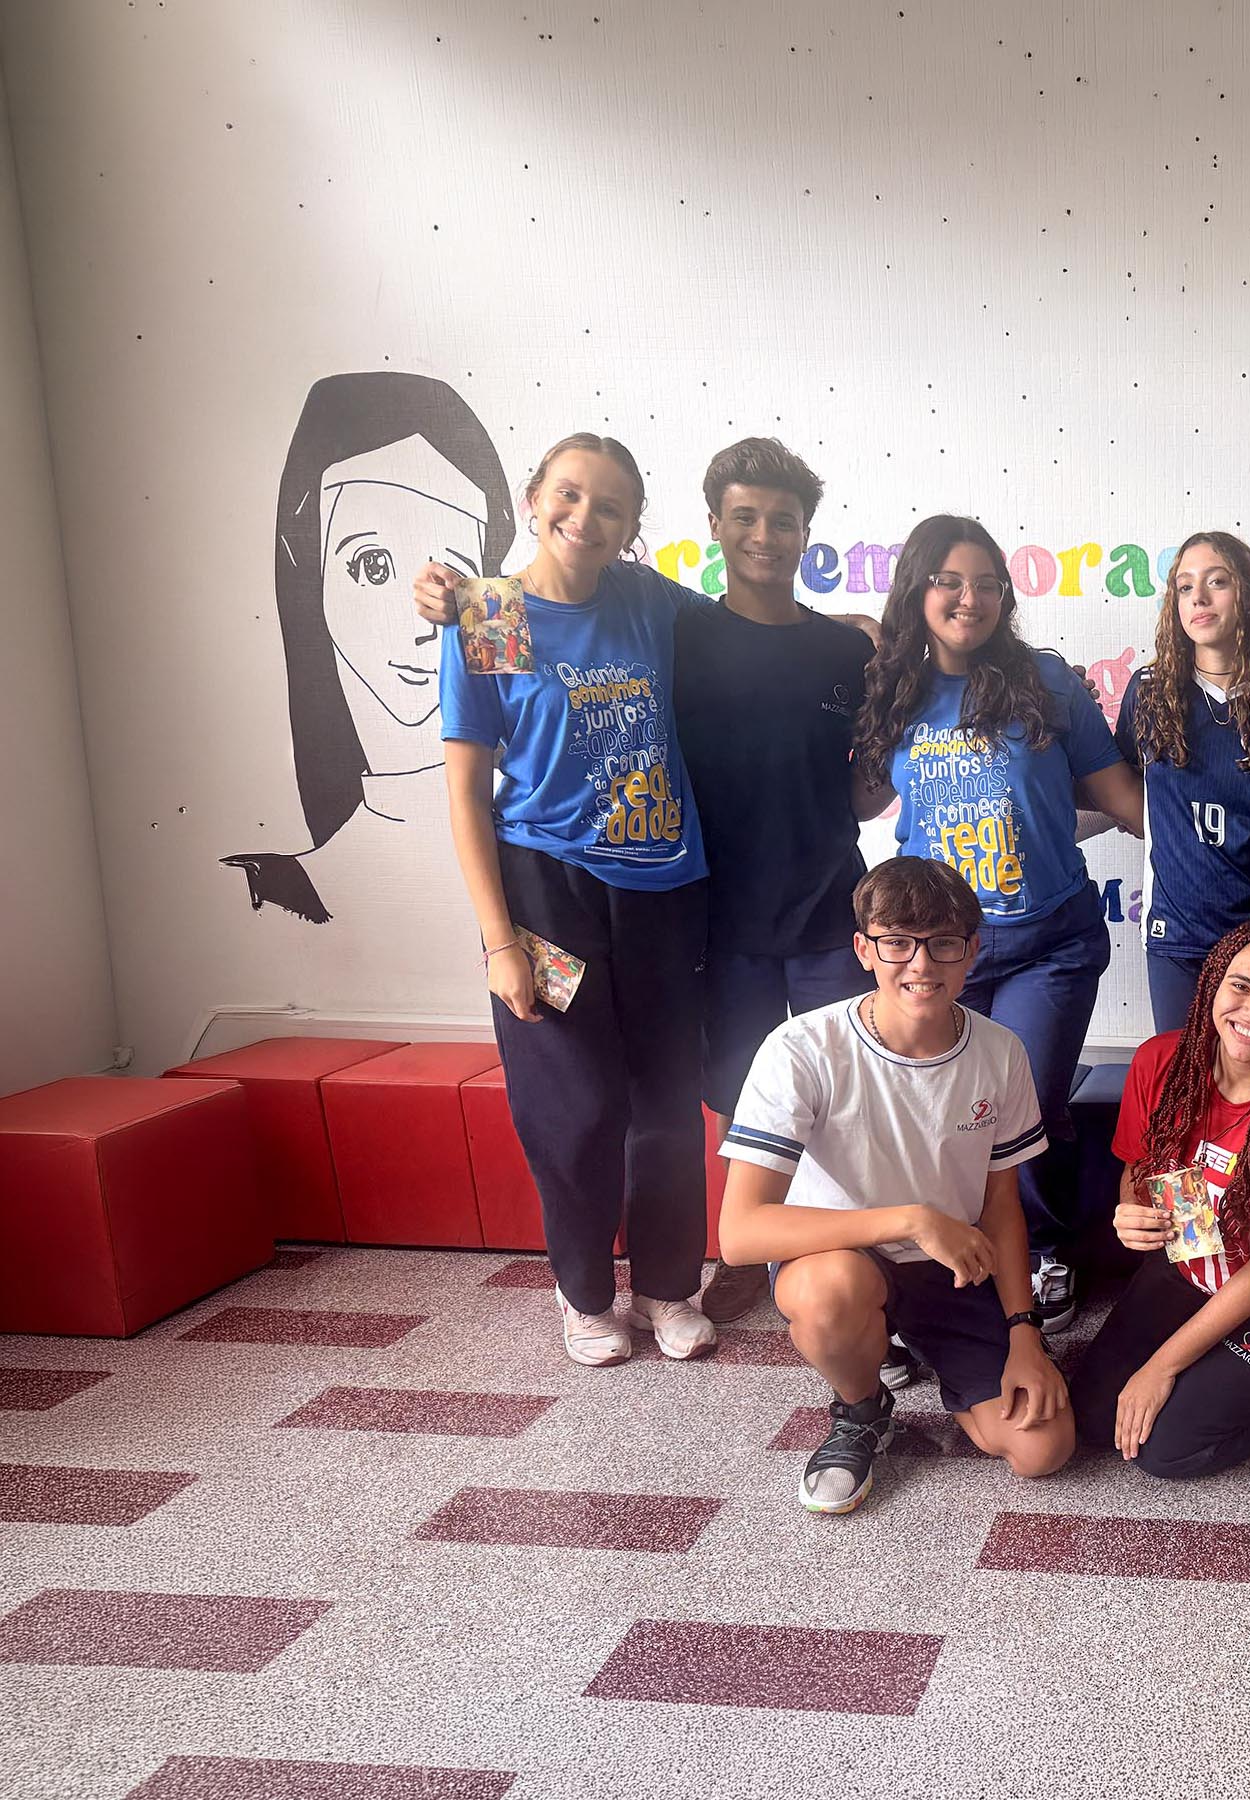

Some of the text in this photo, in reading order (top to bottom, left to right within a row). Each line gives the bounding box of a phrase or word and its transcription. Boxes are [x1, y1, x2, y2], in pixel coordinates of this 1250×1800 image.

[569, 678, 652, 710] sonhamos
[584, 698, 647, 732] juntos
[919, 753, 981, 784] juntos
[920, 764, 1007, 808] apenas
[934, 797, 1012, 829] começo
[1191, 801, 1226, 847] 19
